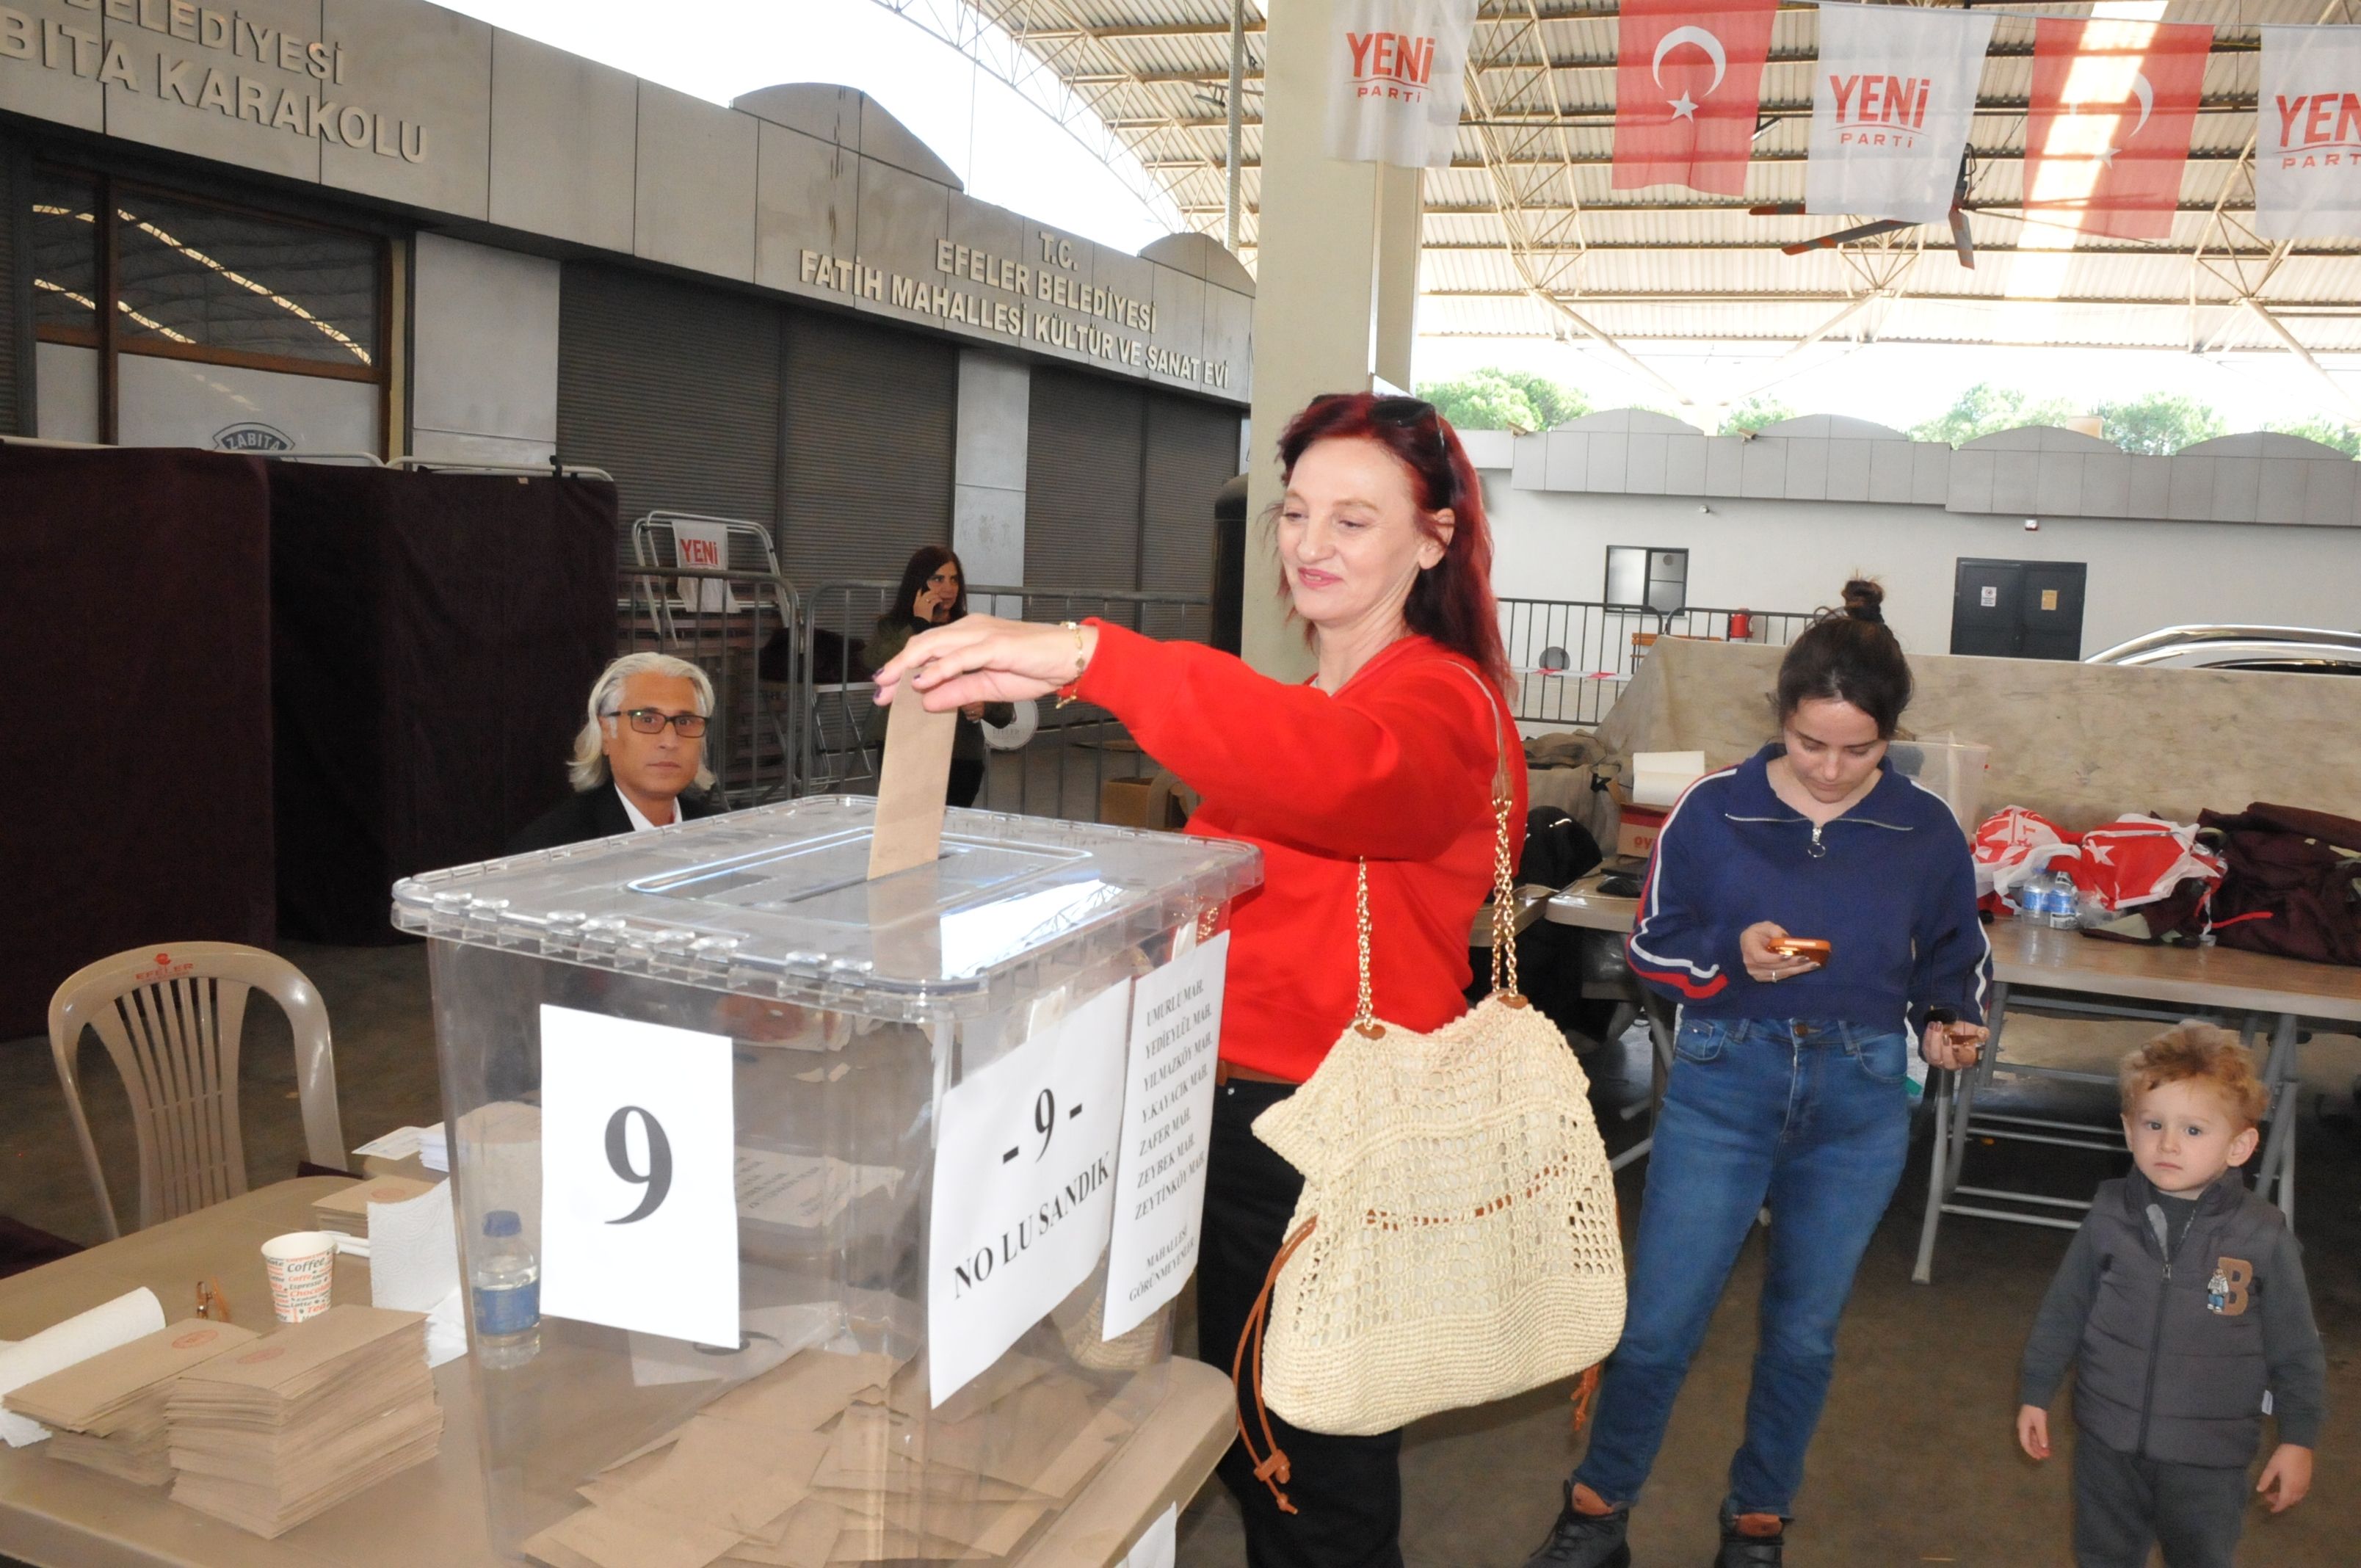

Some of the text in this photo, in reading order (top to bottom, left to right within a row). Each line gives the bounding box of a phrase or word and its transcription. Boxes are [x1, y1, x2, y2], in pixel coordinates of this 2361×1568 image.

[65, 0, 344, 85] ELEDİYESİ
[157, 53, 429, 164] KARAKOLU
[1038, 231, 1078, 271] T.C.
[936, 238, 1157, 334] EFELER BELEDİYESİ
[800, 249, 1229, 389] FATİH MAHALLESİ KÜLTÜR VE SANAT EVİ
[225, 432, 281, 451] ZABITA
[1147, 992, 1181, 1027] UMURLU
[603, 1105, 673, 1225] 9
[1137, 1151, 1175, 1189] ZEYBEK
[1139, 1122, 1171, 1157] ZAFER
[954, 1150, 1109, 1299] NO LU SANDIK
[287, 1257, 325, 1273] Coffee
